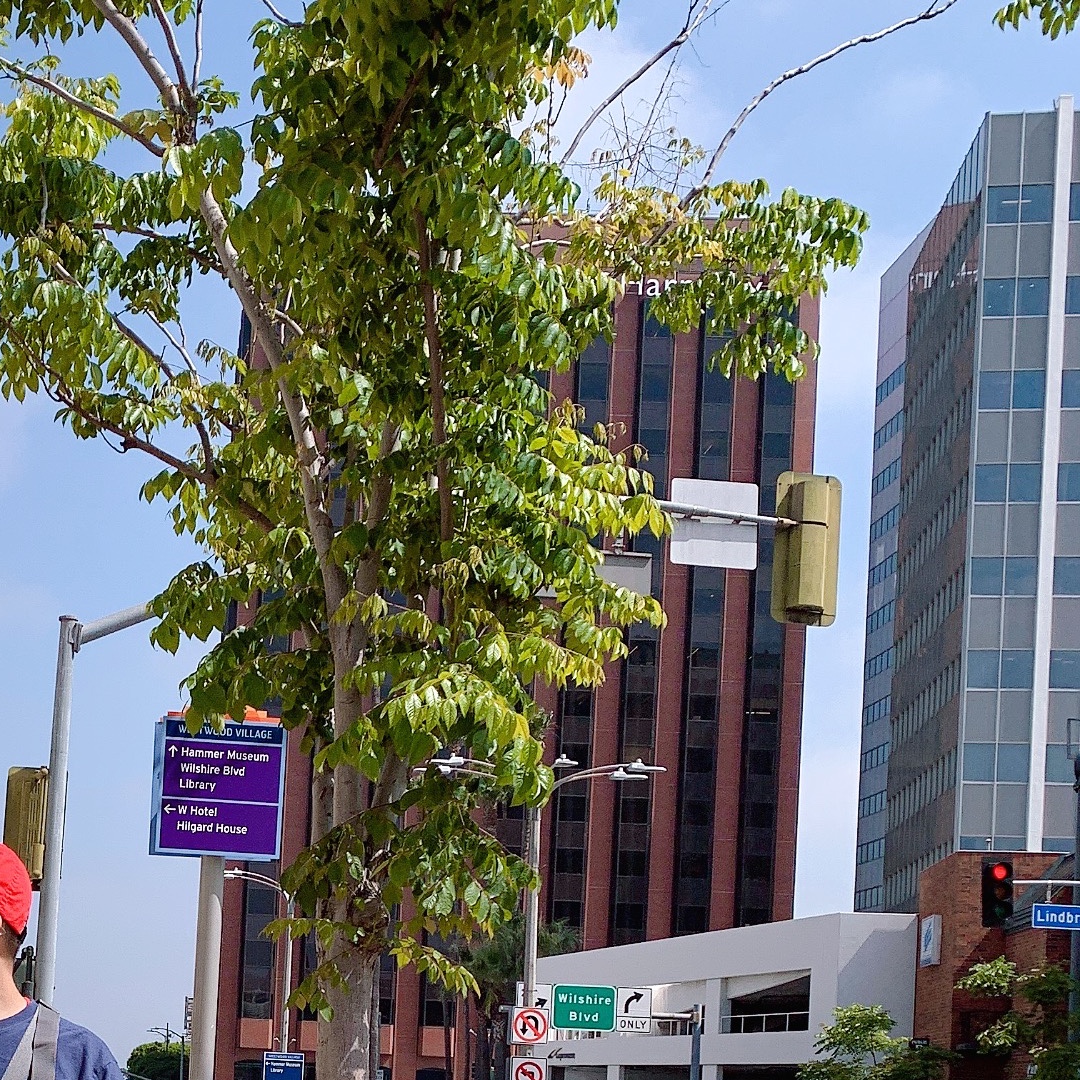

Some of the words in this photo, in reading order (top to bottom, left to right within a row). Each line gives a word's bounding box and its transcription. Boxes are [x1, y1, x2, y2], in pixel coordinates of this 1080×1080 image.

[235, 728, 273, 740] VILLAGE
[181, 746, 225, 759] Hammer
[227, 750, 269, 762] Museum
[180, 763, 220, 775] Wilshire
[223, 766, 246, 777] Blvd
[179, 778, 217, 792] Library
[178, 804, 188, 815] W
[190, 805, 218, 817] Hotel
[176, 820, 214, 834] Hilgard
[215, 823, 248, 835] House
[1037, 909, 1080, 924] Lindbr
[558, 993, 612, 1006] Wilshire
[569, 1011, 599, 1022] Blvd
[620, 1020, 647, 1029] ONLY
